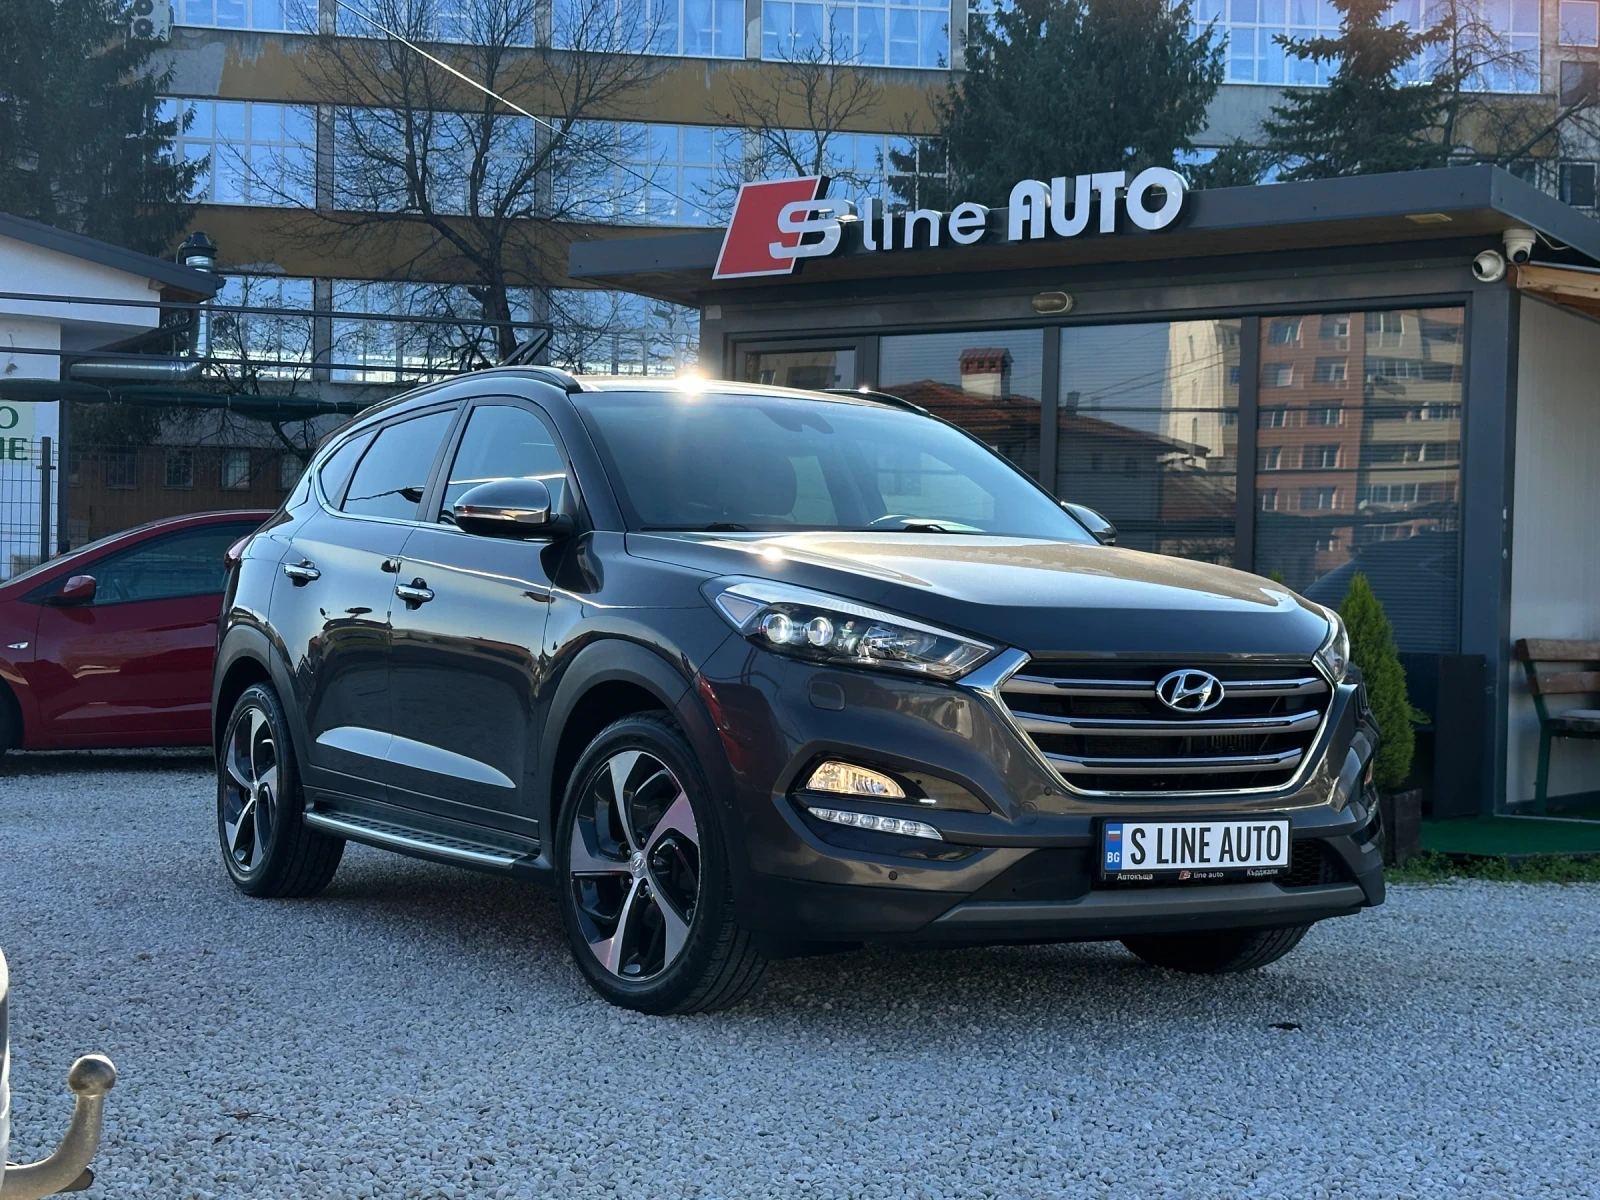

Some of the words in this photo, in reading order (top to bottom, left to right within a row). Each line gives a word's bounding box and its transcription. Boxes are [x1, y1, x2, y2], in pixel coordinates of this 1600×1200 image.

[769, 200, 841, 259] S
[863, 198, 986, 251] line
[1008, 166, 1185, 241] AUTO
[1130, 828, 1146, 864] S
[1156, 827, 1211, 864] LINE
[1219, 825, 1281, 862] AUTO
[1107, 852, 1120, 863] BG
[1117, 872, 1153, 881] Автокъща
